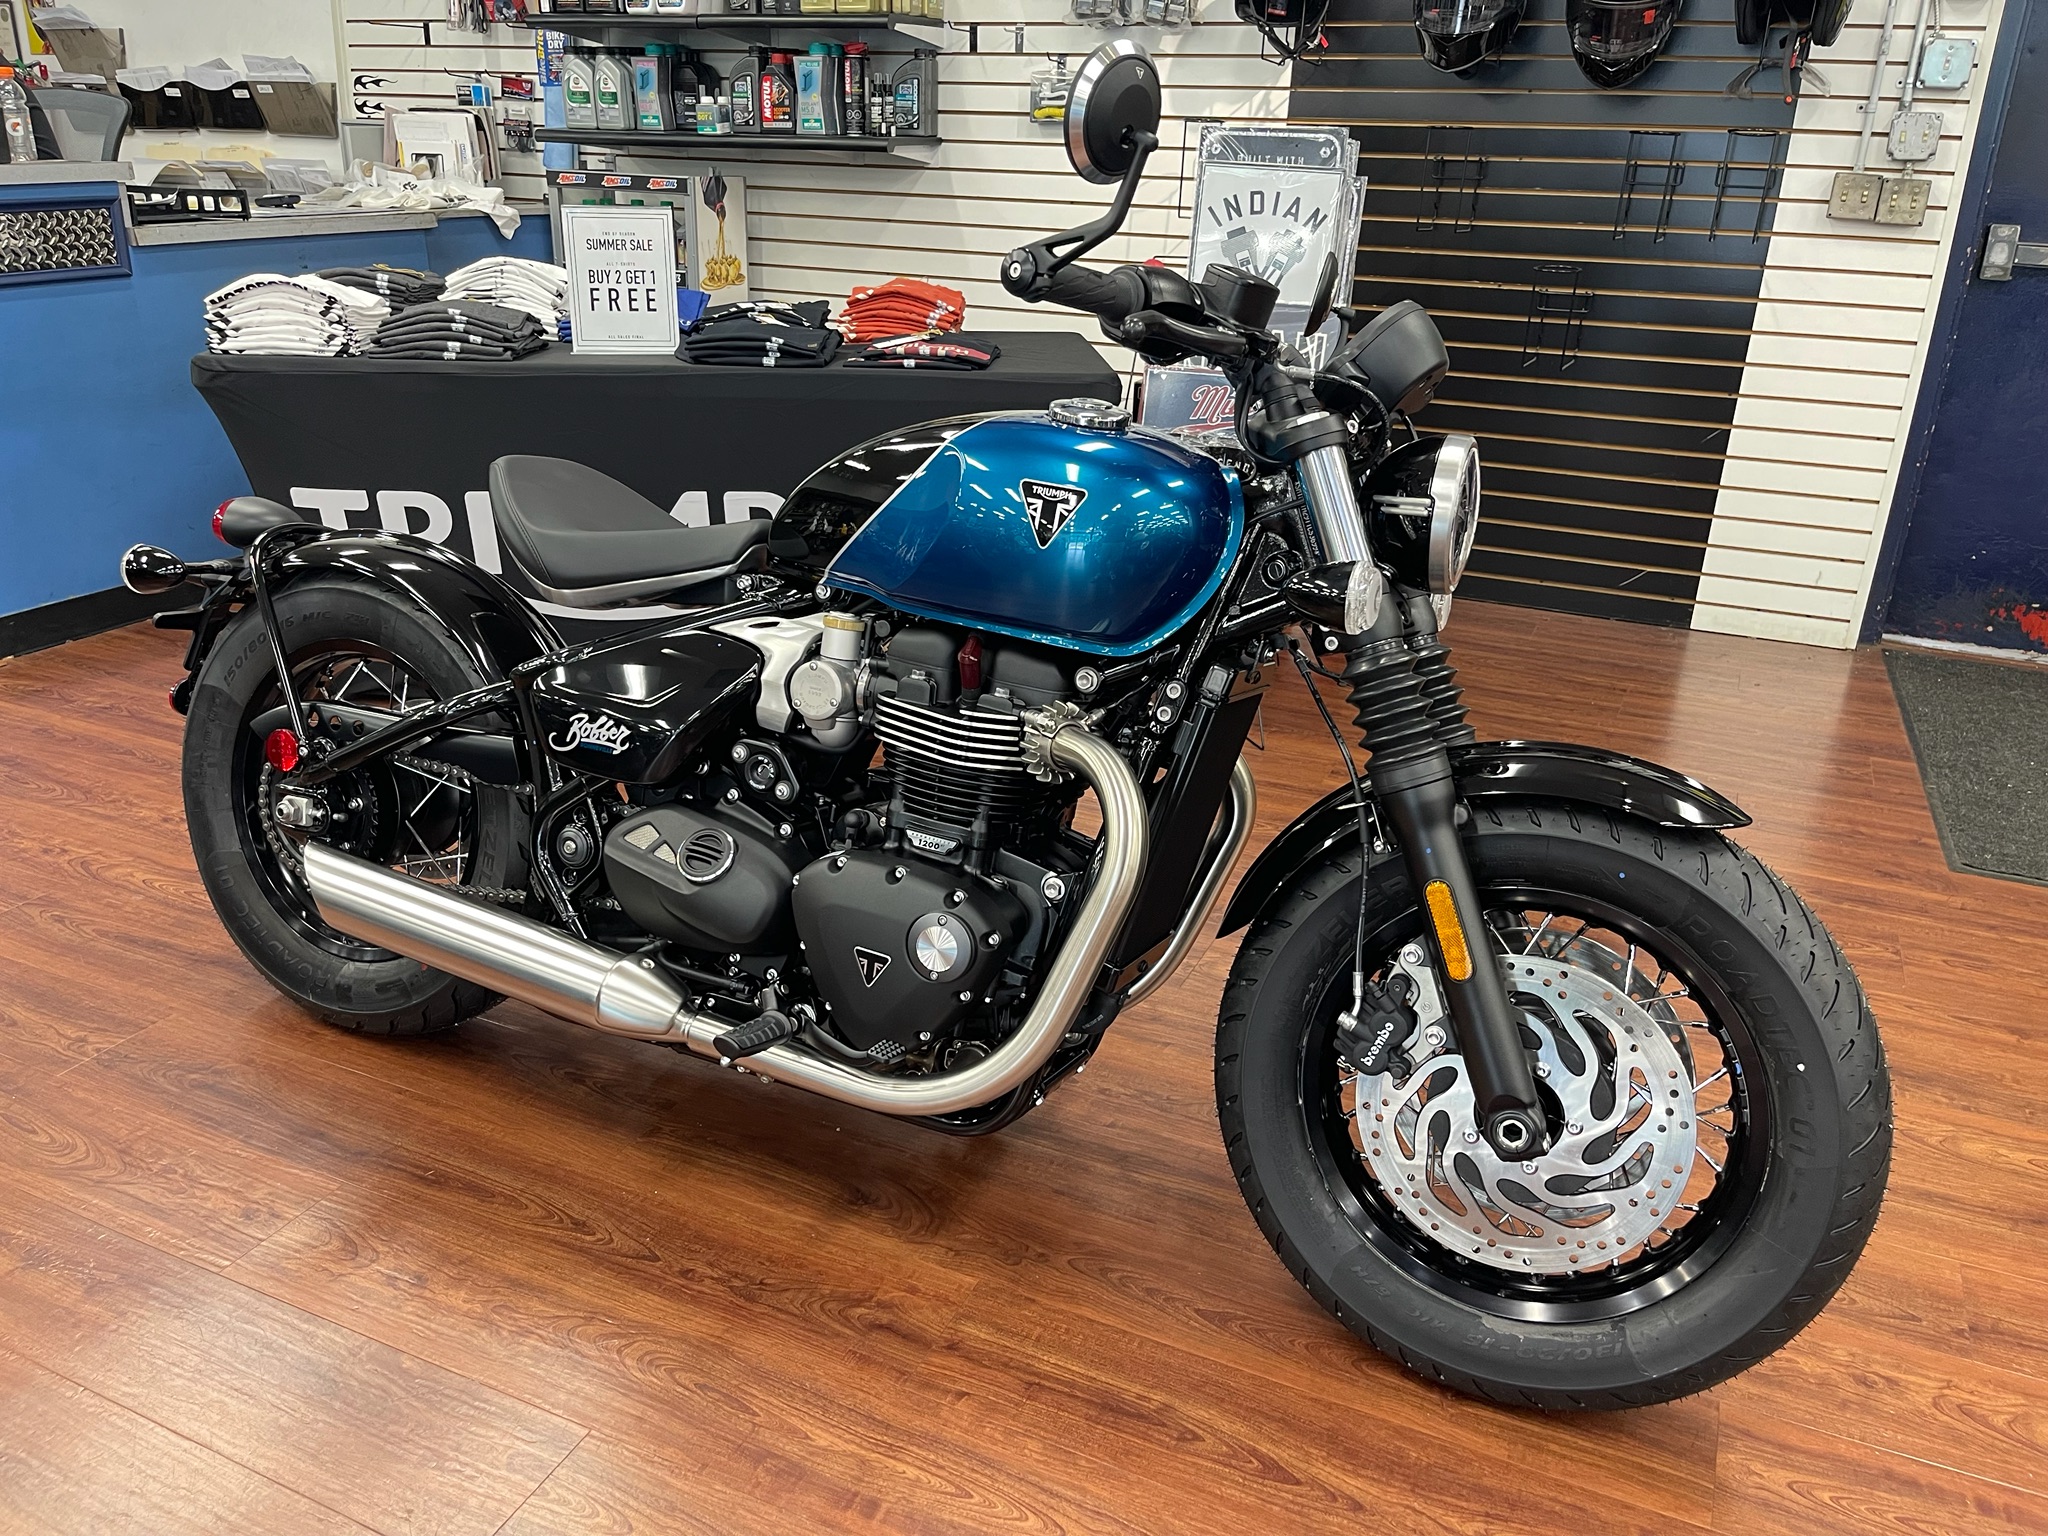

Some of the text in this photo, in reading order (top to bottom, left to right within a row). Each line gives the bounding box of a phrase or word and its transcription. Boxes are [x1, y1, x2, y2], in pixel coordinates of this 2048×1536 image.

[546, 31, 565, 40] BIKE
[548, 40, 563, 49] DRY
[763, 81, 772, 119] MOTUL
[1275, 155, 1305, 165] WITH
[558, 174, 586, 183] AMSOIL
[603, 176, 631, 185] AMSOIL
[649, 178, 677, 188] AMSOIL
[1207, 190, 1329, 236] INDIAN
[586, 238, 653, 251] SUMMER SALE
[588, 269, 656, 284] BUY 2 GET 1
[589, 287, 658, 312] FREE
[1032, 485, 1073, 500] TRIUMPH
[548, 712, 632, 755] Bobber
[918, 838, 940, 850] 1200
[1360, 1022, 1394, 1066] brembo
